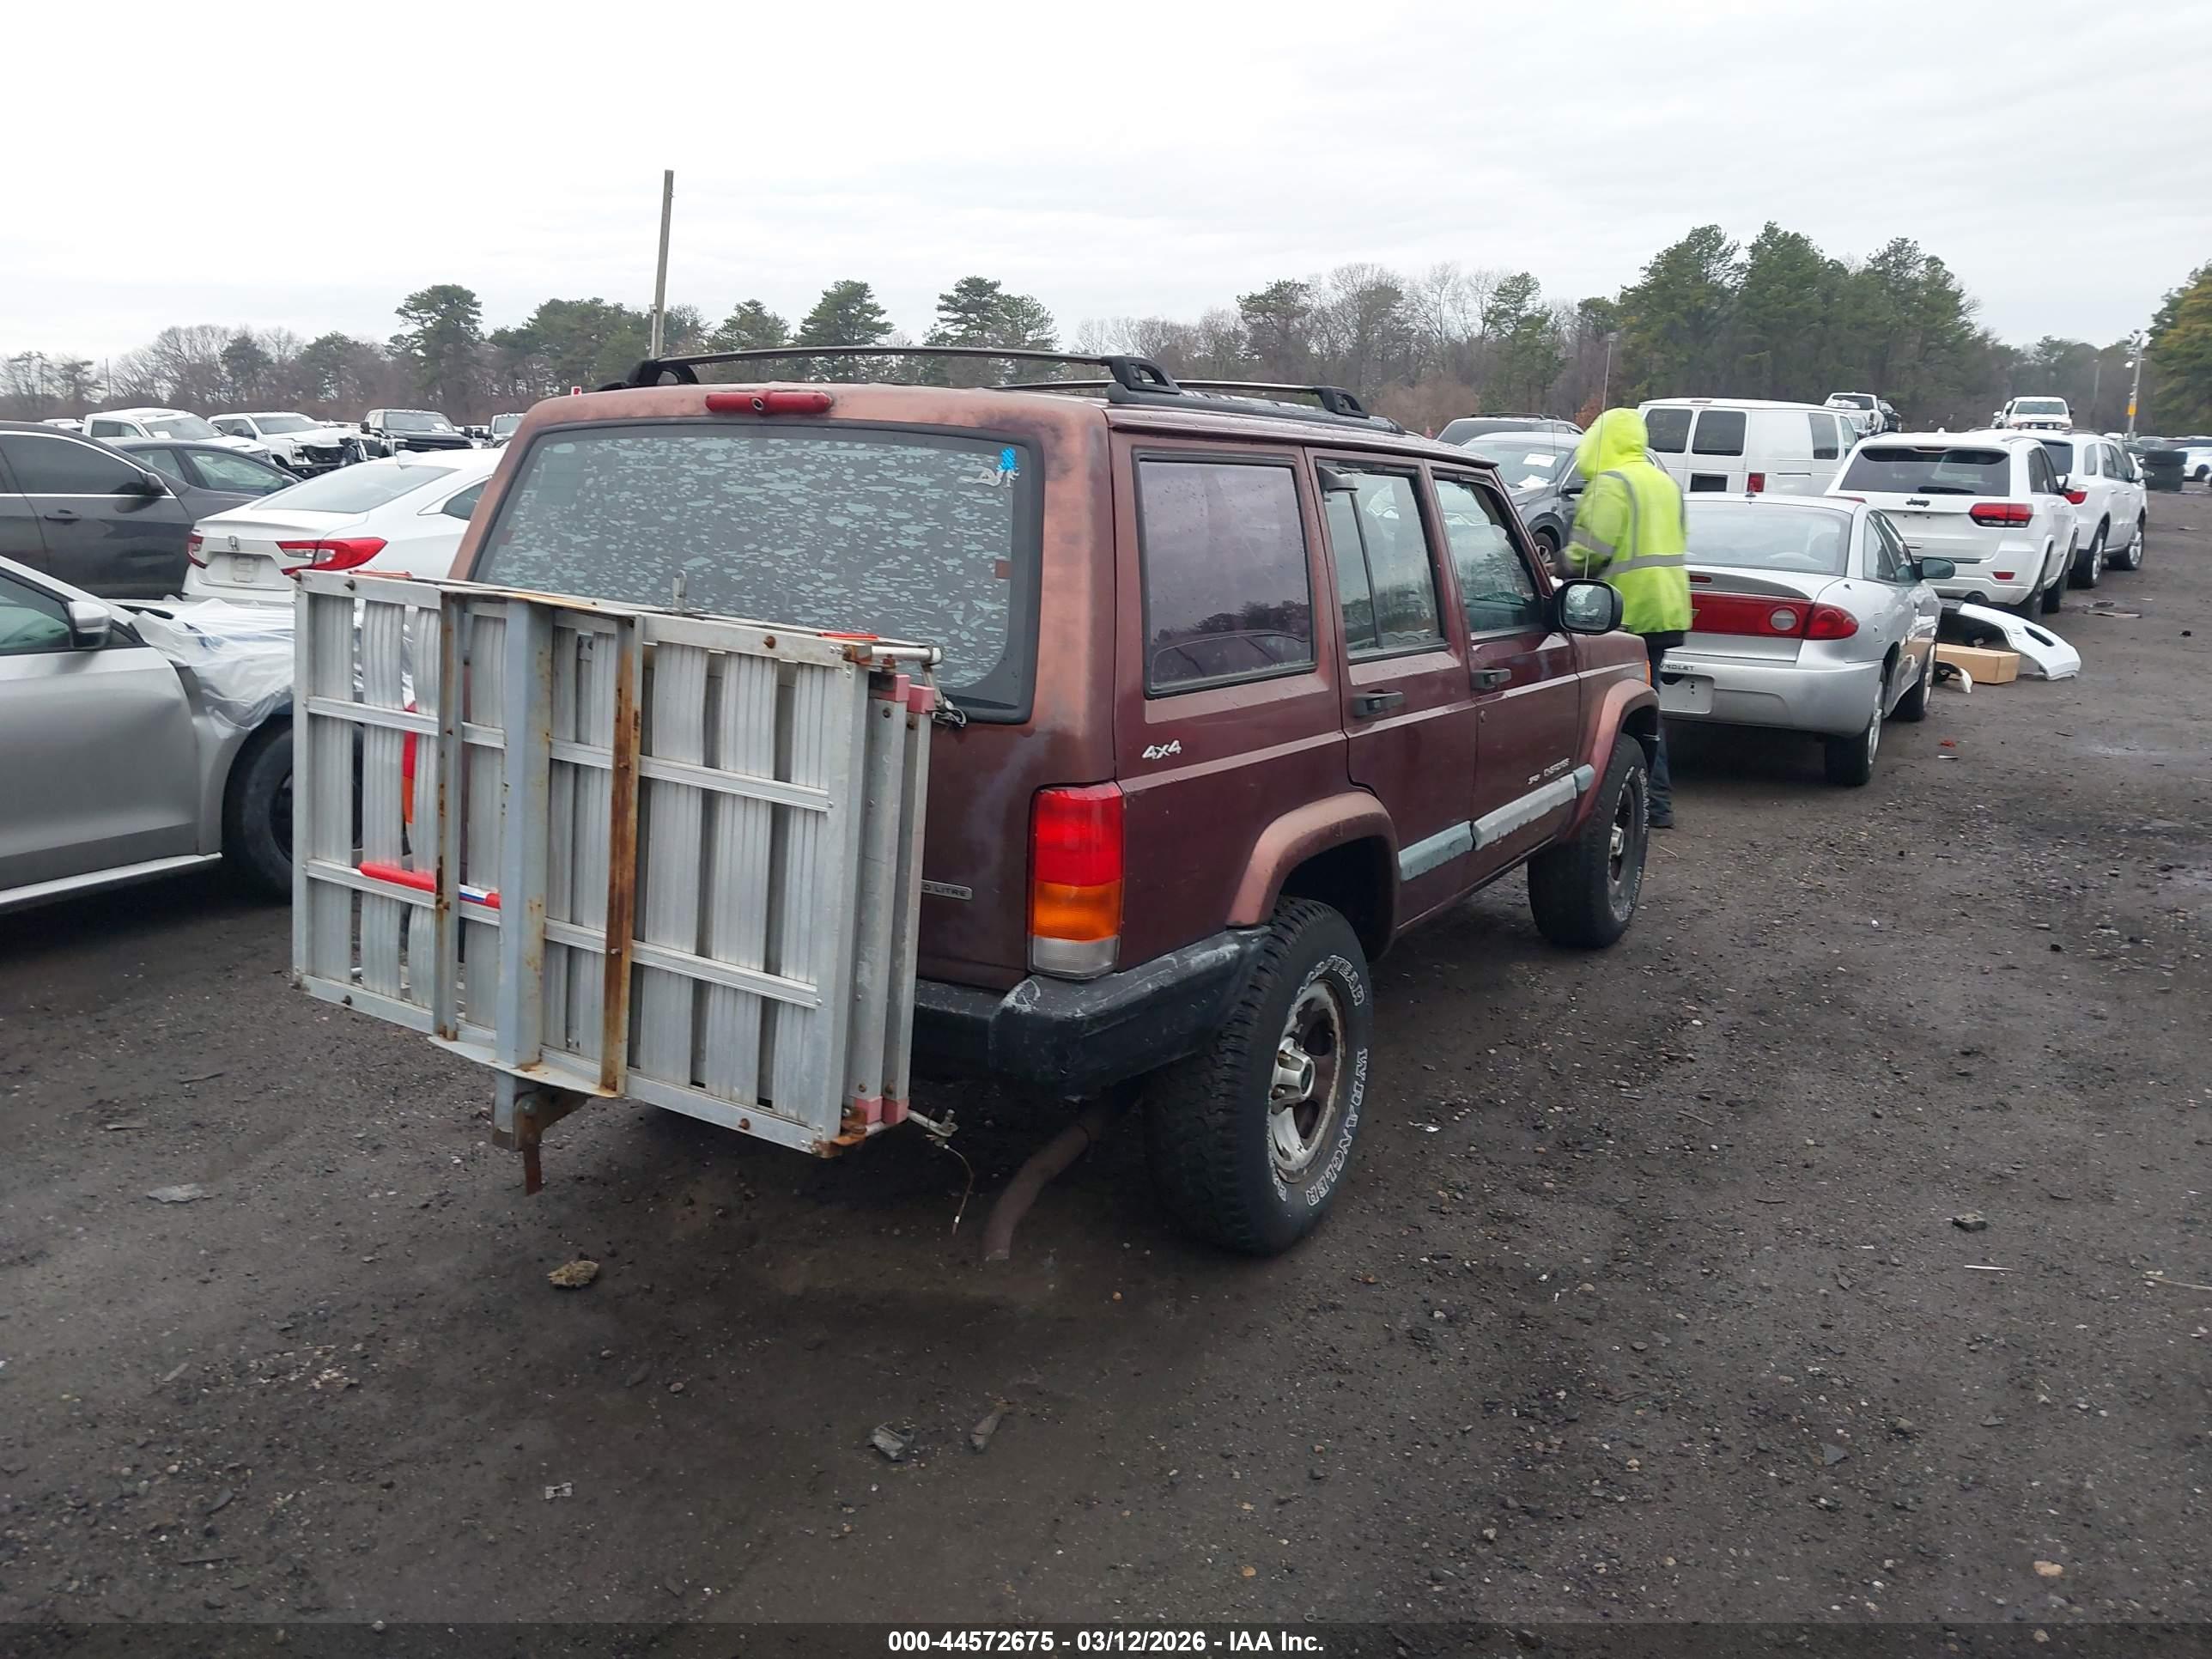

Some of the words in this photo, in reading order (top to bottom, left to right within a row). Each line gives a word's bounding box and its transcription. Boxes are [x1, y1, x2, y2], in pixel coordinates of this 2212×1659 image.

[1905, 497, 1930, 507] Jeep
[935, 886, 967, 896] LITRE
[1305, 1048, 1368, 1206] WRANGLER
